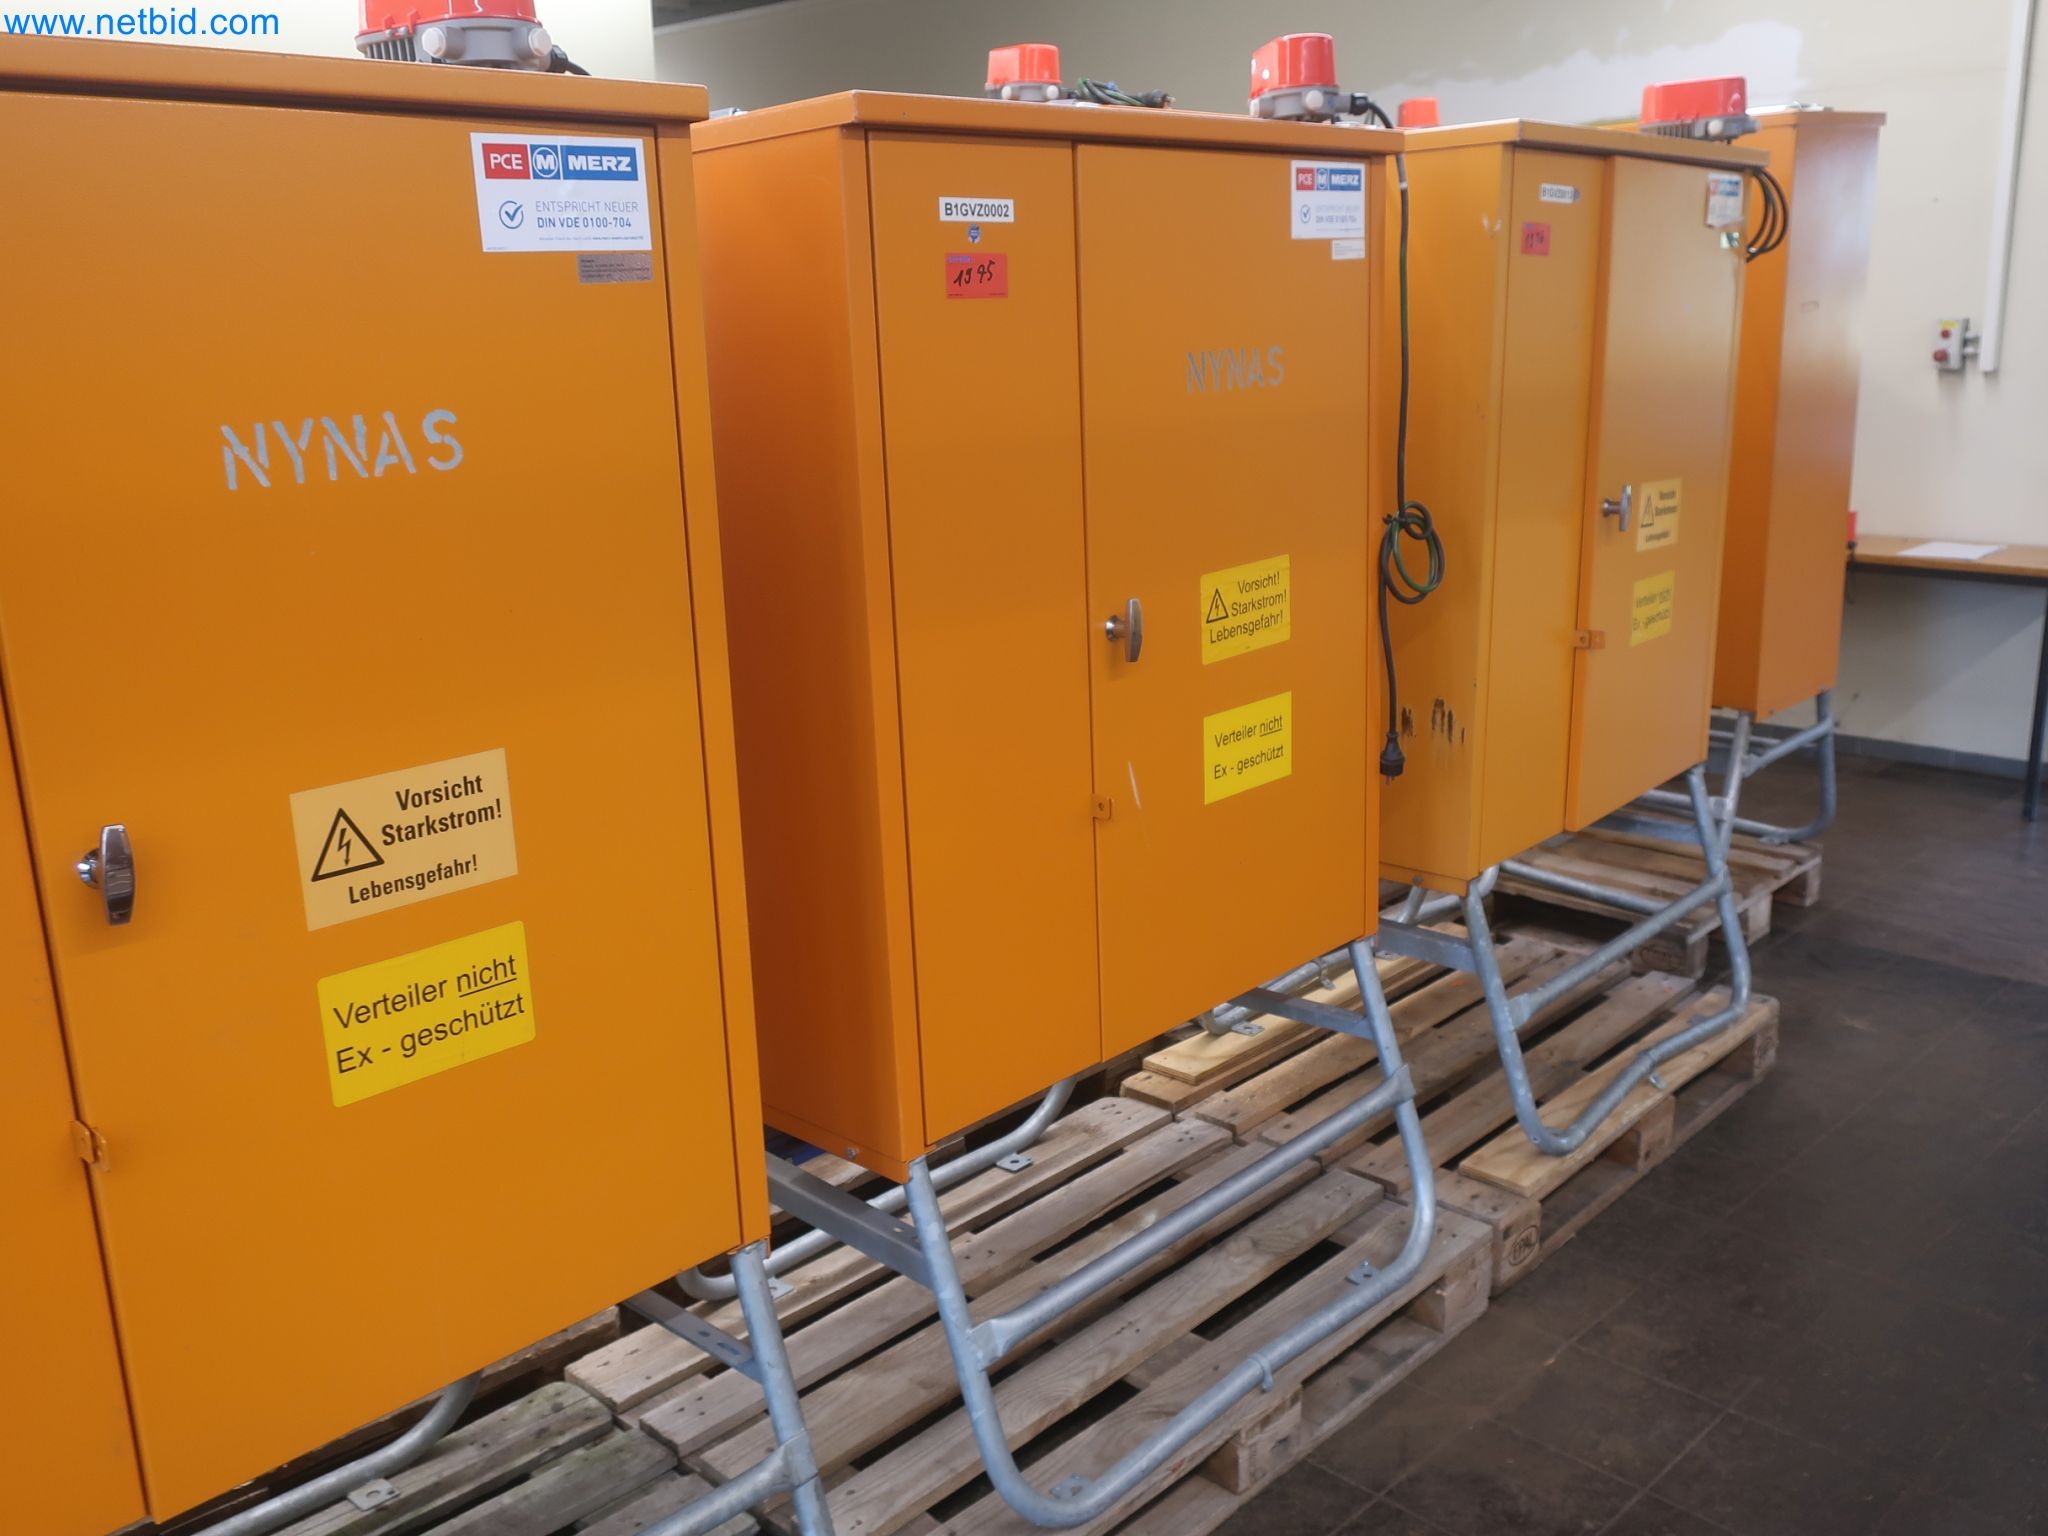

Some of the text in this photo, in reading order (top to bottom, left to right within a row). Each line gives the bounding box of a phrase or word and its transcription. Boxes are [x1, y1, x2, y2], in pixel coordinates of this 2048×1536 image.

[489, 152, 524, 170] PCE
[567, 154, 632, 172] MERZ
[1298, 172, 1313, 186] PCE
[1331, 173, 1360, 186] MERZ
[535, 200, 639, 213] ENTSPRICHT NEUER
[537, 216, 632, 229] DIN VDE 0100-704
[944, 202, 1010, 218] B1GVZ0002
[1186, 345, 1285, 395] NYNAS
[220, 408, 464, 491] NYNAS
[1237, 571, 1280, 595] Vorsicht!
[1231, 589, 1288, 617] Starkstrom!
[1209, 609, 1284, 644] Lebensgefahr!
[1214, 715, 1283, 748] Verteiler nicht
[1213, 763, 1228, 780] Ex
[1237, 744, 1285, 774] geschützt
[395, 774, 484, 812] Vorsicht
[381, 798, 503, 847] Starkstrom!
[348, 853, 479, 904] Lebensgefahr!
[332, 954, 517, 1030] Verteiler nicht
[335, 1045, 374, 1075] Ex
[400, 993, 526, 1059] geschützt
